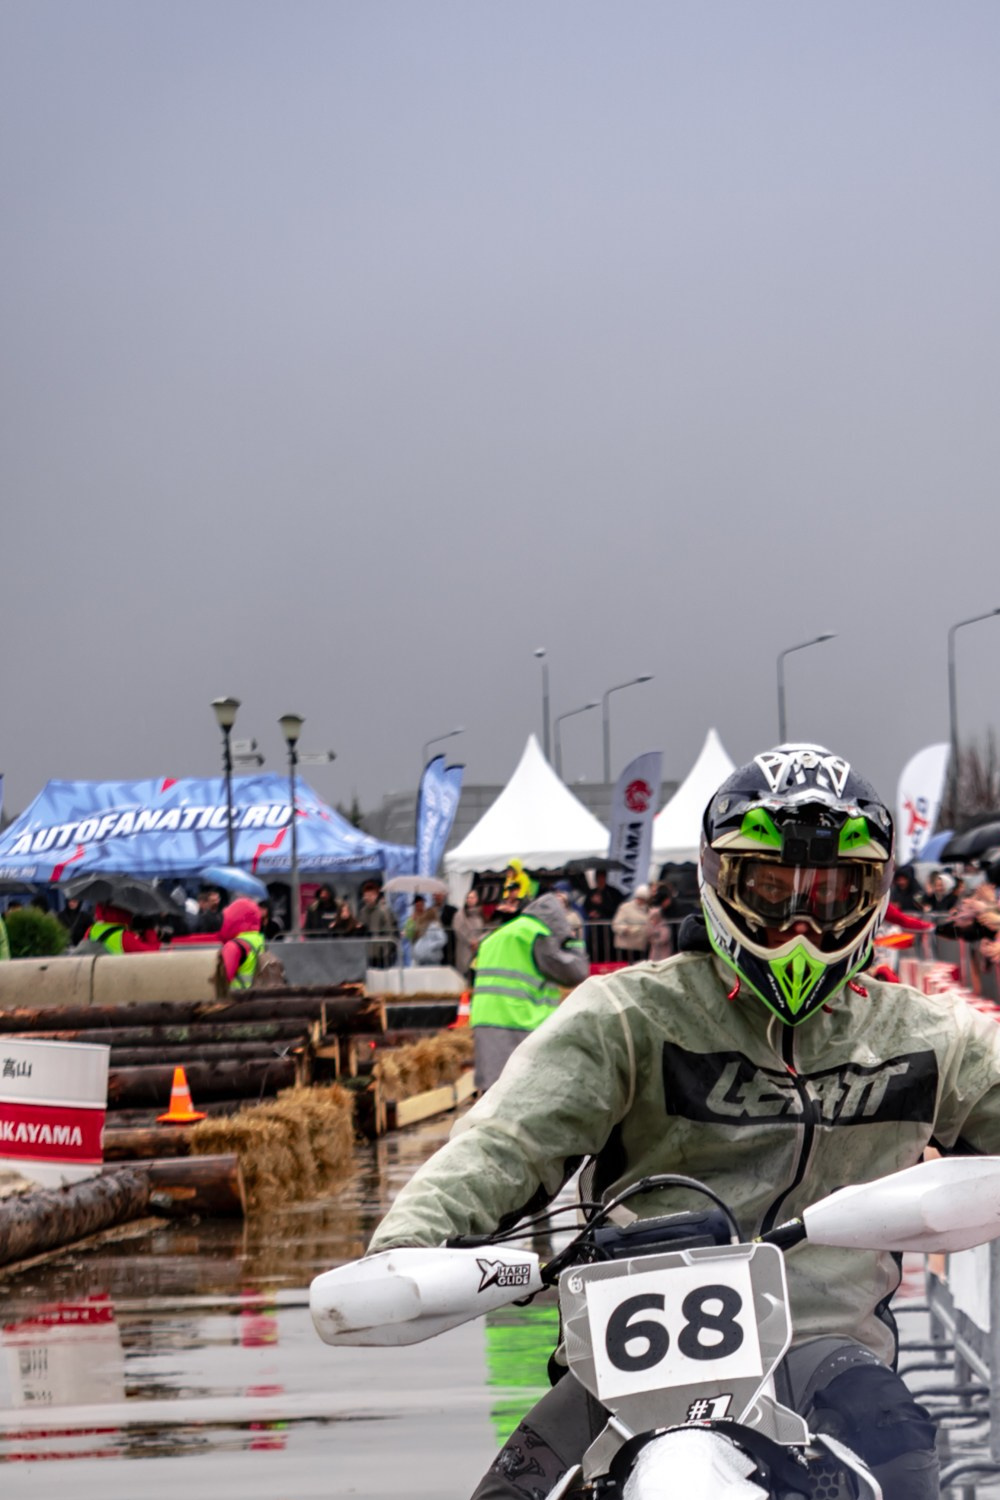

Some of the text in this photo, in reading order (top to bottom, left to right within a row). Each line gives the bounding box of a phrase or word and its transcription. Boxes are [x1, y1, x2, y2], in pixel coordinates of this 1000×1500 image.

[4, 805, 294, 856] AUTOFANATIC.RU
[498, 1265, 529, 1277] HARD
[498, 1275, 529, 1286] GLIDE
[605, 1283, 745, 1373] 68
